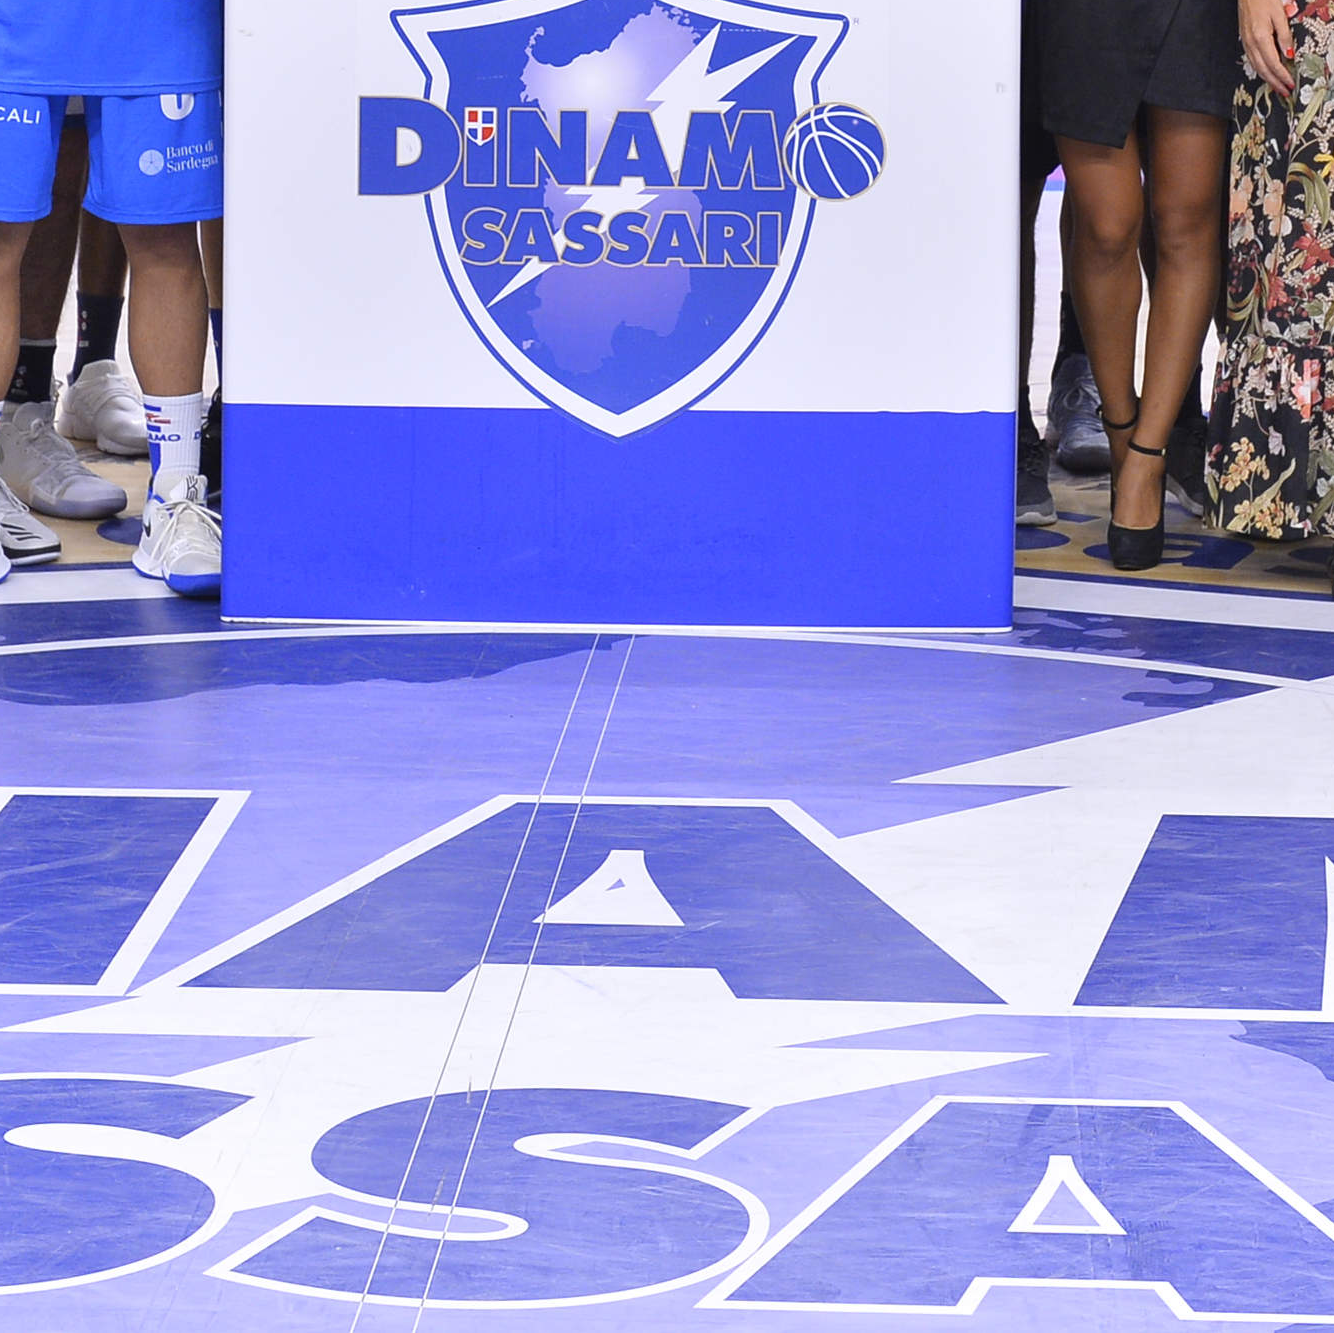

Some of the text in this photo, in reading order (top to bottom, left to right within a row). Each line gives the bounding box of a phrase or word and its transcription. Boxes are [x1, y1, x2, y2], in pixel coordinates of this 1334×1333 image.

[166, 139, 215, 160] Banco di
[166, 153, 219, 173] Sardegna
[459, 207, 782, 268] SASSARI
